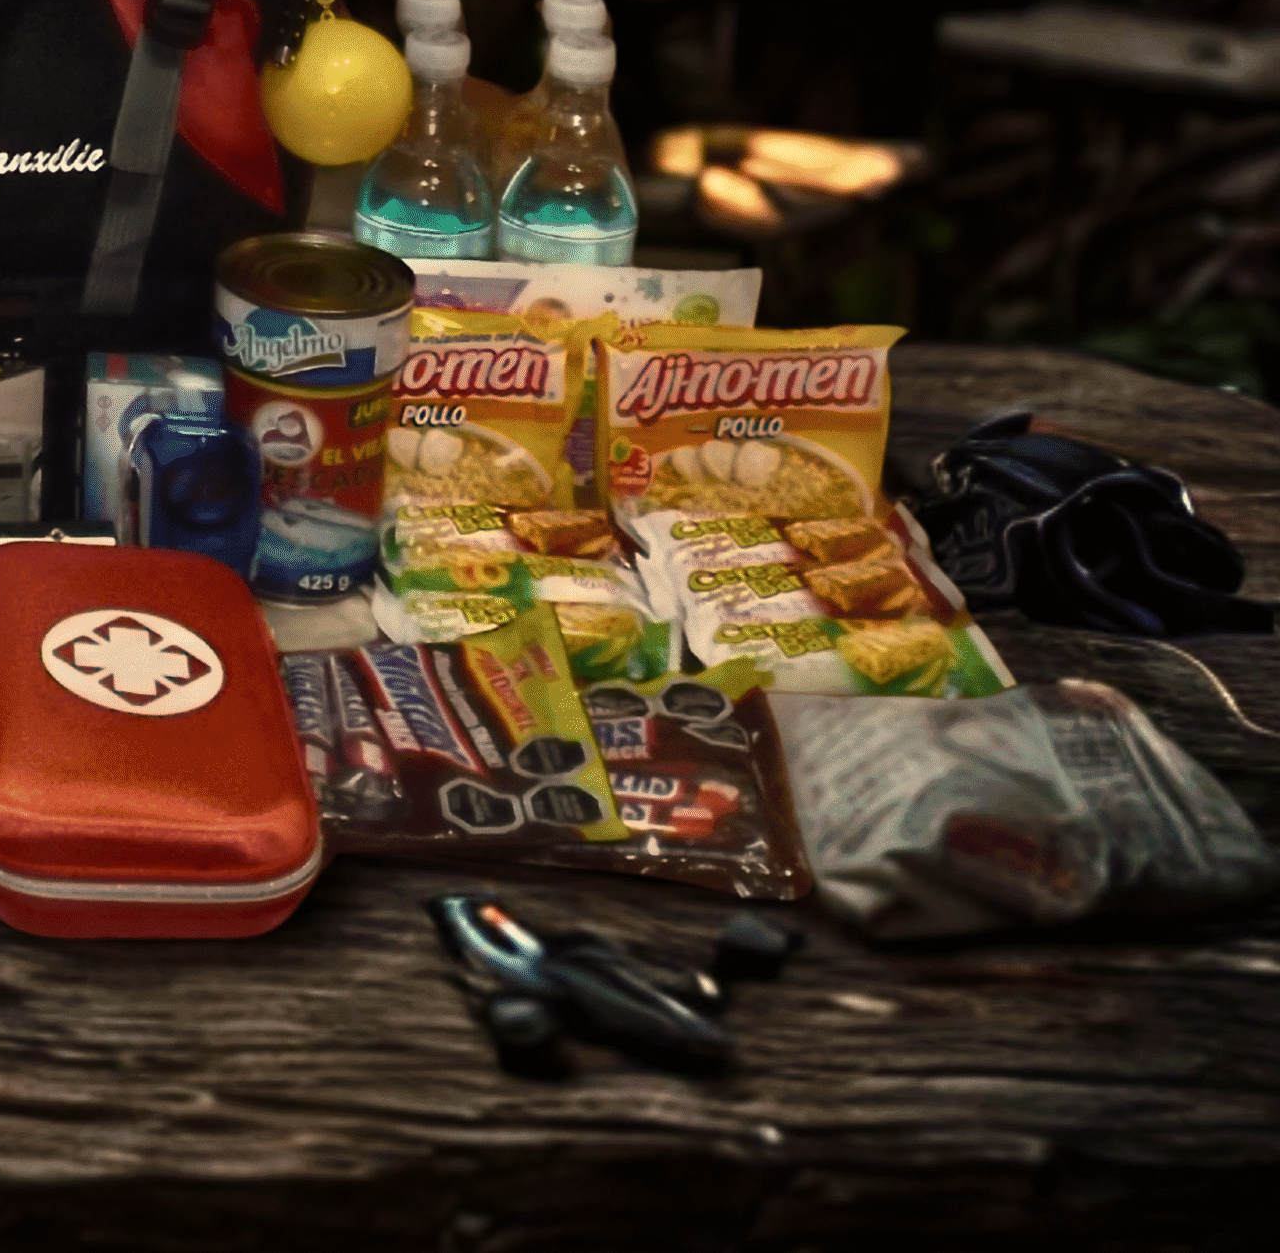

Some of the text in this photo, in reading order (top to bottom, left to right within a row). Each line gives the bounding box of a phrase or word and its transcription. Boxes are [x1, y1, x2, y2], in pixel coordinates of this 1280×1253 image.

[223, 321, 345, 371] Angelmo
[400, 405, 468, 428] POLLO
[716, 415, 784, 439] POLLO
[322, 448, 345, 467] EL
[730, 527, 784, 548] Bar
[298, 574, 334, 591] 425
[747, 575, 805, 599] Bar
[774, 634, 836, 658] Bar
